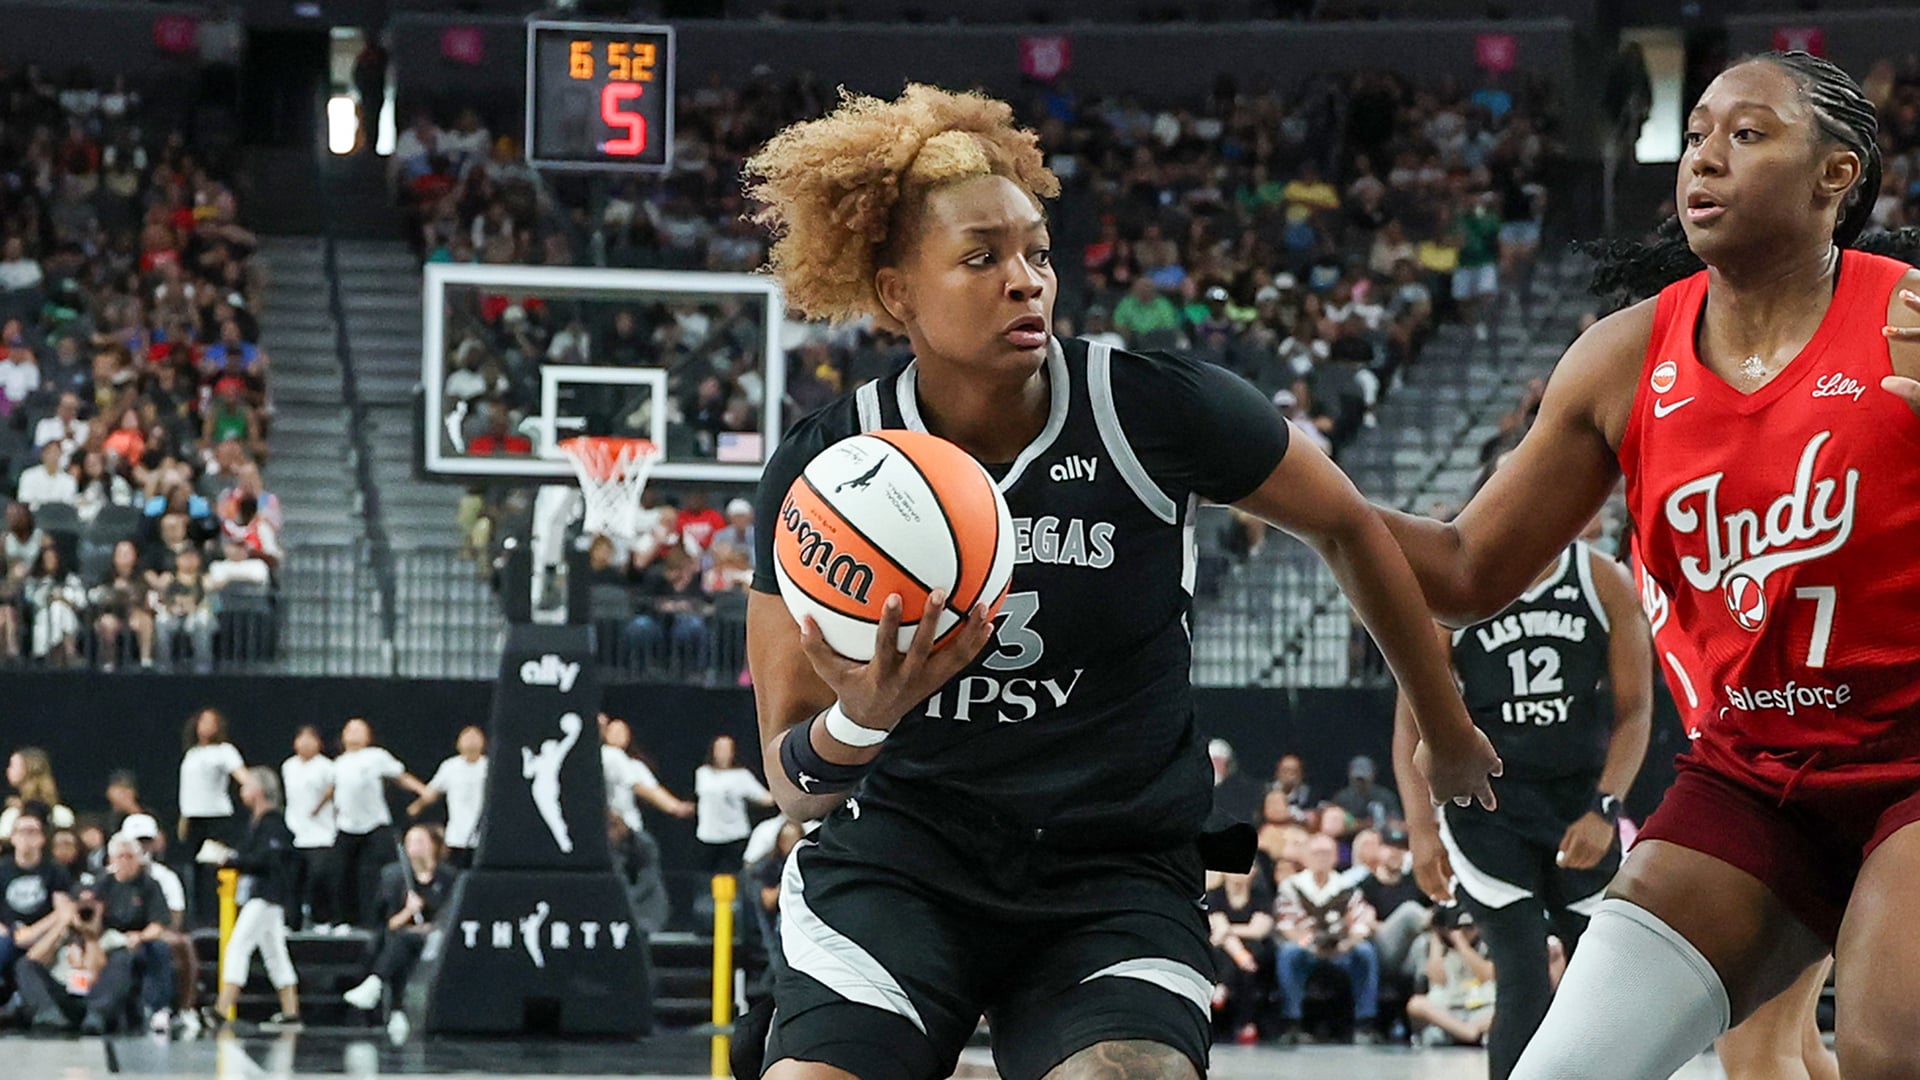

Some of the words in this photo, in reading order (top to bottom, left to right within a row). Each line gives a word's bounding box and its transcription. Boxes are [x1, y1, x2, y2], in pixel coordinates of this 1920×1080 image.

[569, 40, 595, 80] 6
[607, 42, 657, 82] 52
[601, 81, 647, 156] 5
[1811, 372, 1867, 402] Lilly
[1049, 455, 1098, 482] ally
[1665, 430, 1860, 592] Indy
[781, 488, 875, 606] Wilson
[1011, 515, 1116, 569] EGAS
[982, 591, 1044, 671] 3
[1476, 615, 1523, 653] LAS
[1795, 585, 1836, 669] 7
[520, 653, 580, 693] ally
[924, 668, 1084, 723] IPSY
[1507, 645, 1563, 696] 12
[1501, 695, 1575, 726] IPSY
